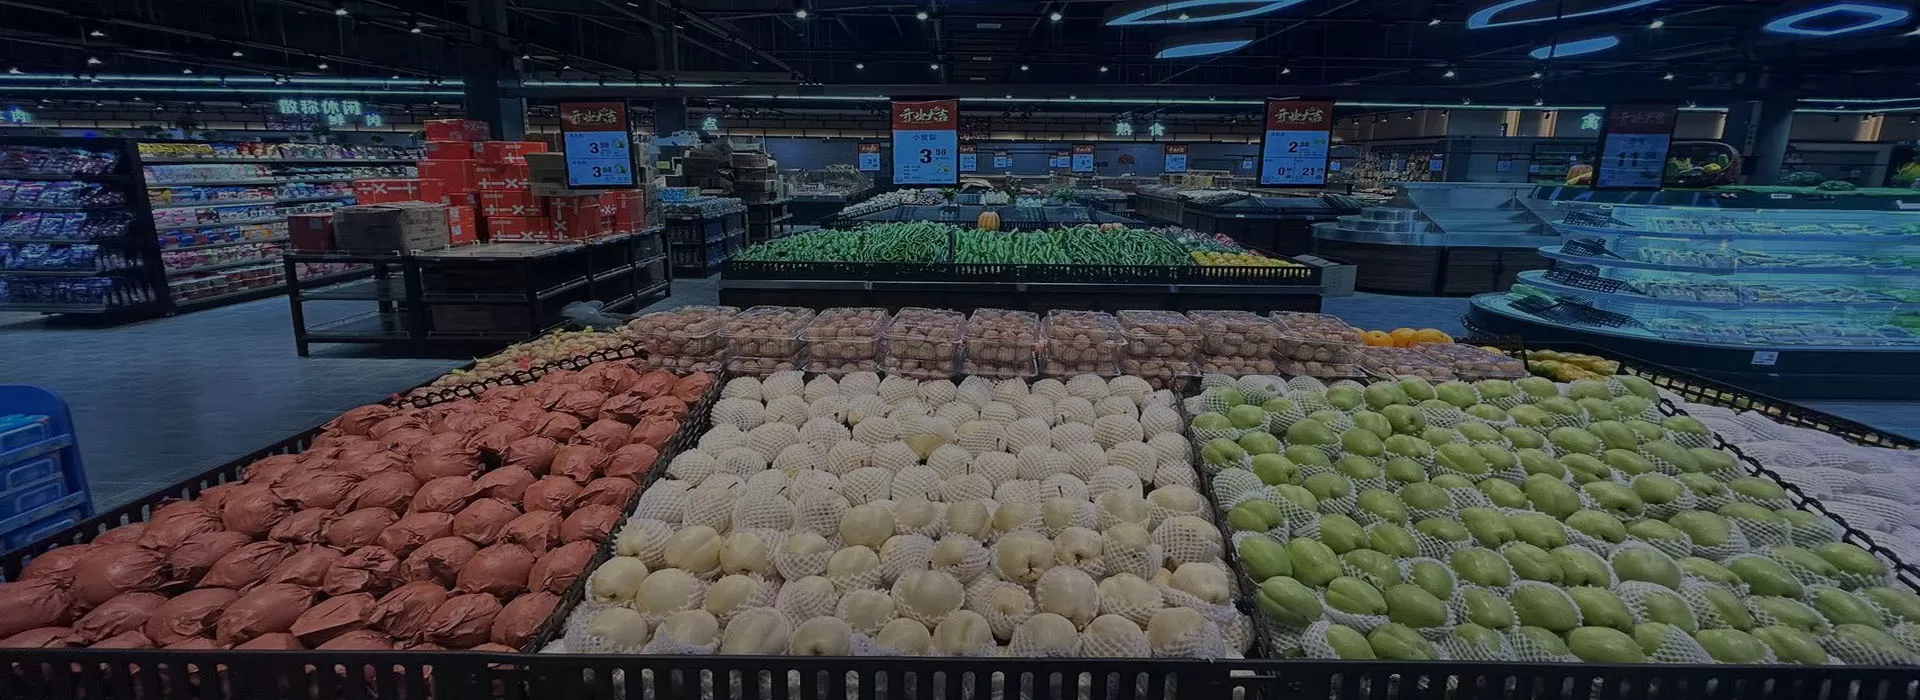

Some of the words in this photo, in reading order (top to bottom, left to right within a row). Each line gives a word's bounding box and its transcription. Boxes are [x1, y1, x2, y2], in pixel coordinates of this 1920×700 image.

[278, 98, 361, 115] 散称休闲
[899, 106, 949, 123] 开业大吉
[1274, 106, 1325, 123] 开业大吉
[919, 148, 933, 164] 3
